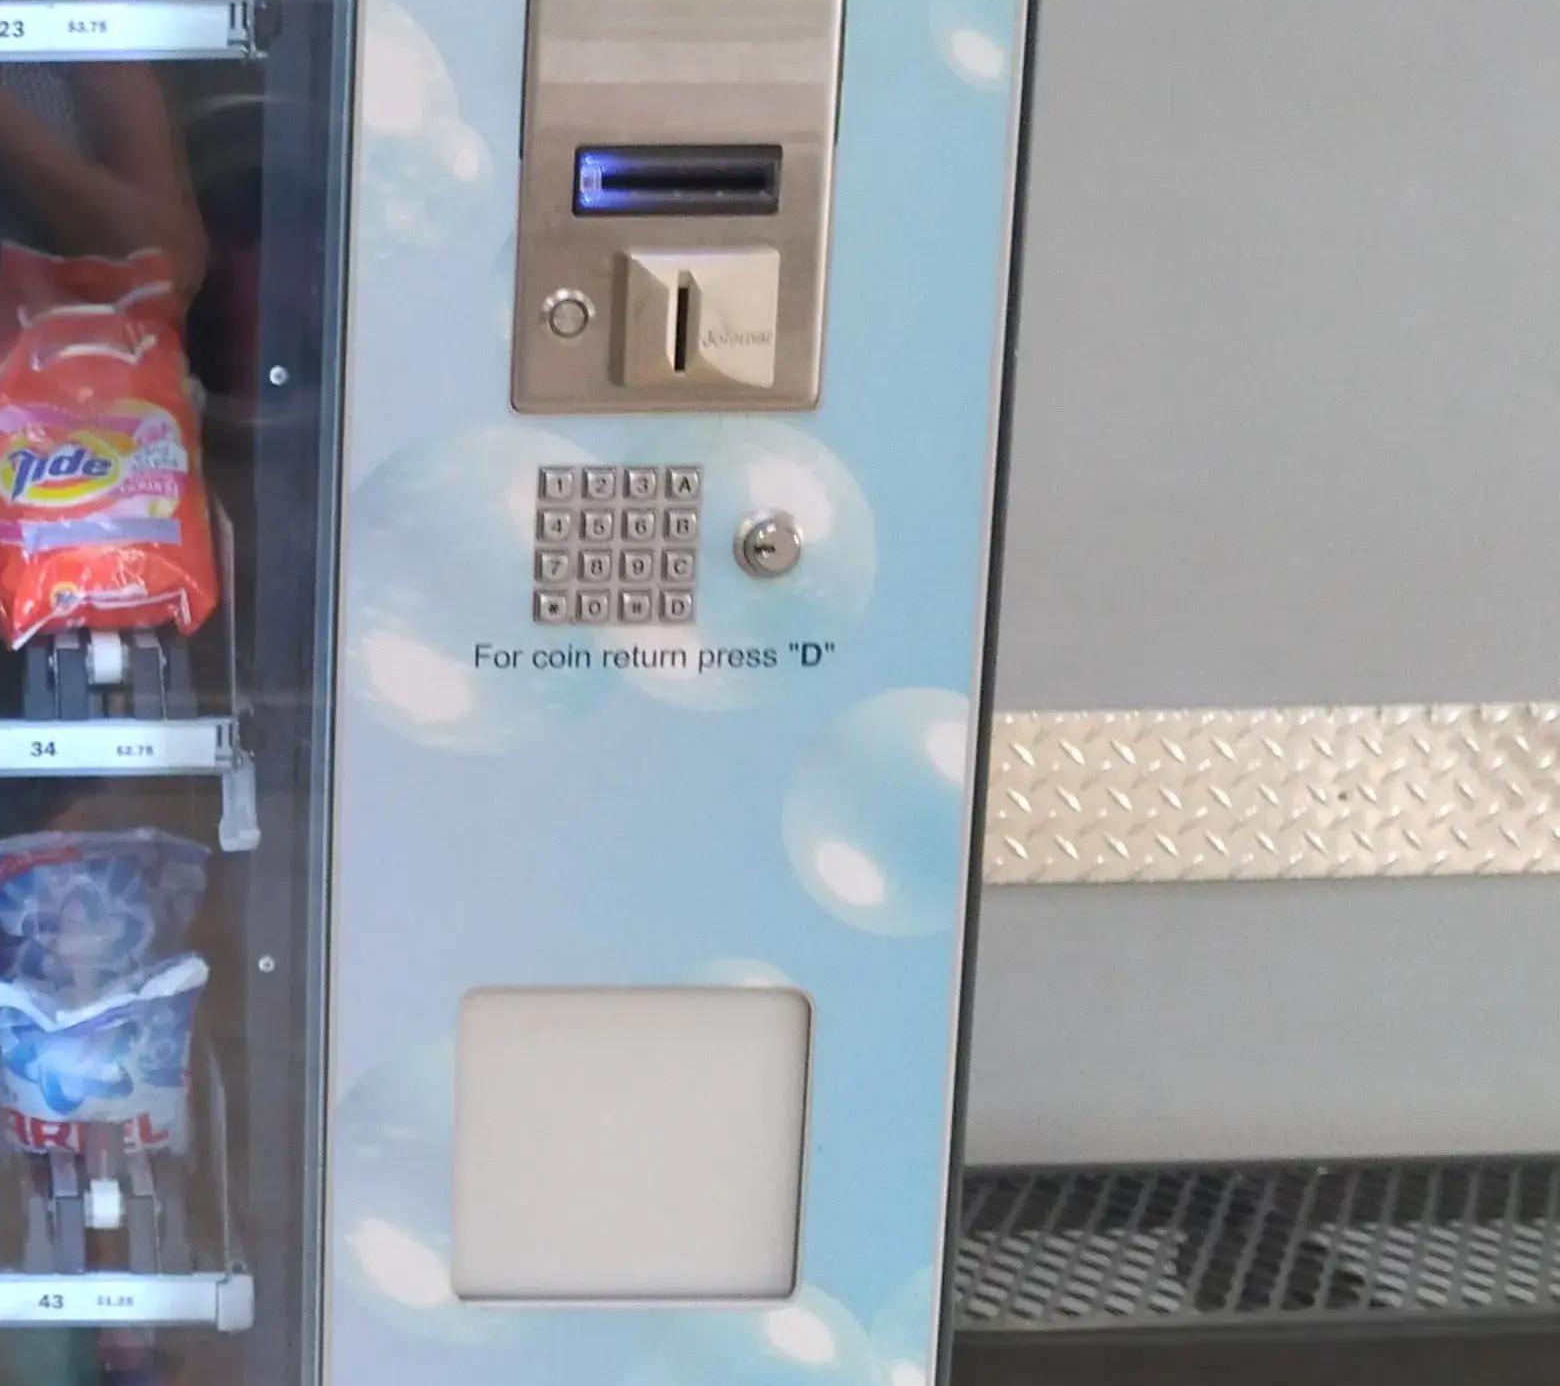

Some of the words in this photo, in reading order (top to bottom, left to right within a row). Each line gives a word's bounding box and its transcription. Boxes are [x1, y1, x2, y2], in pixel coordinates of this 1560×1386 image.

[8, 447, 113, 503] Tide
[594, 477, 607, 494] 2
[636, 477, 649, 494] 3
[678, 476, 691, 493] A
[551, 518, 562, 534] 4
[549, 559, 561, 575] 7
[591, 558, 603, 576] 8
[632, 558, 645, 575] 9
[673, 558, 687, 575] C
[671, 600, 685, 616] D
[474, 642, 523, 669] For
[532, 642, 591, 669] coin
[602, 643, 687, 669] return
[698, 645, 779, 674] press
[788, 641, 836, 668] "D"
[30, 740, 58, 758] 34
[38, 1293, 65, 1310] 43
